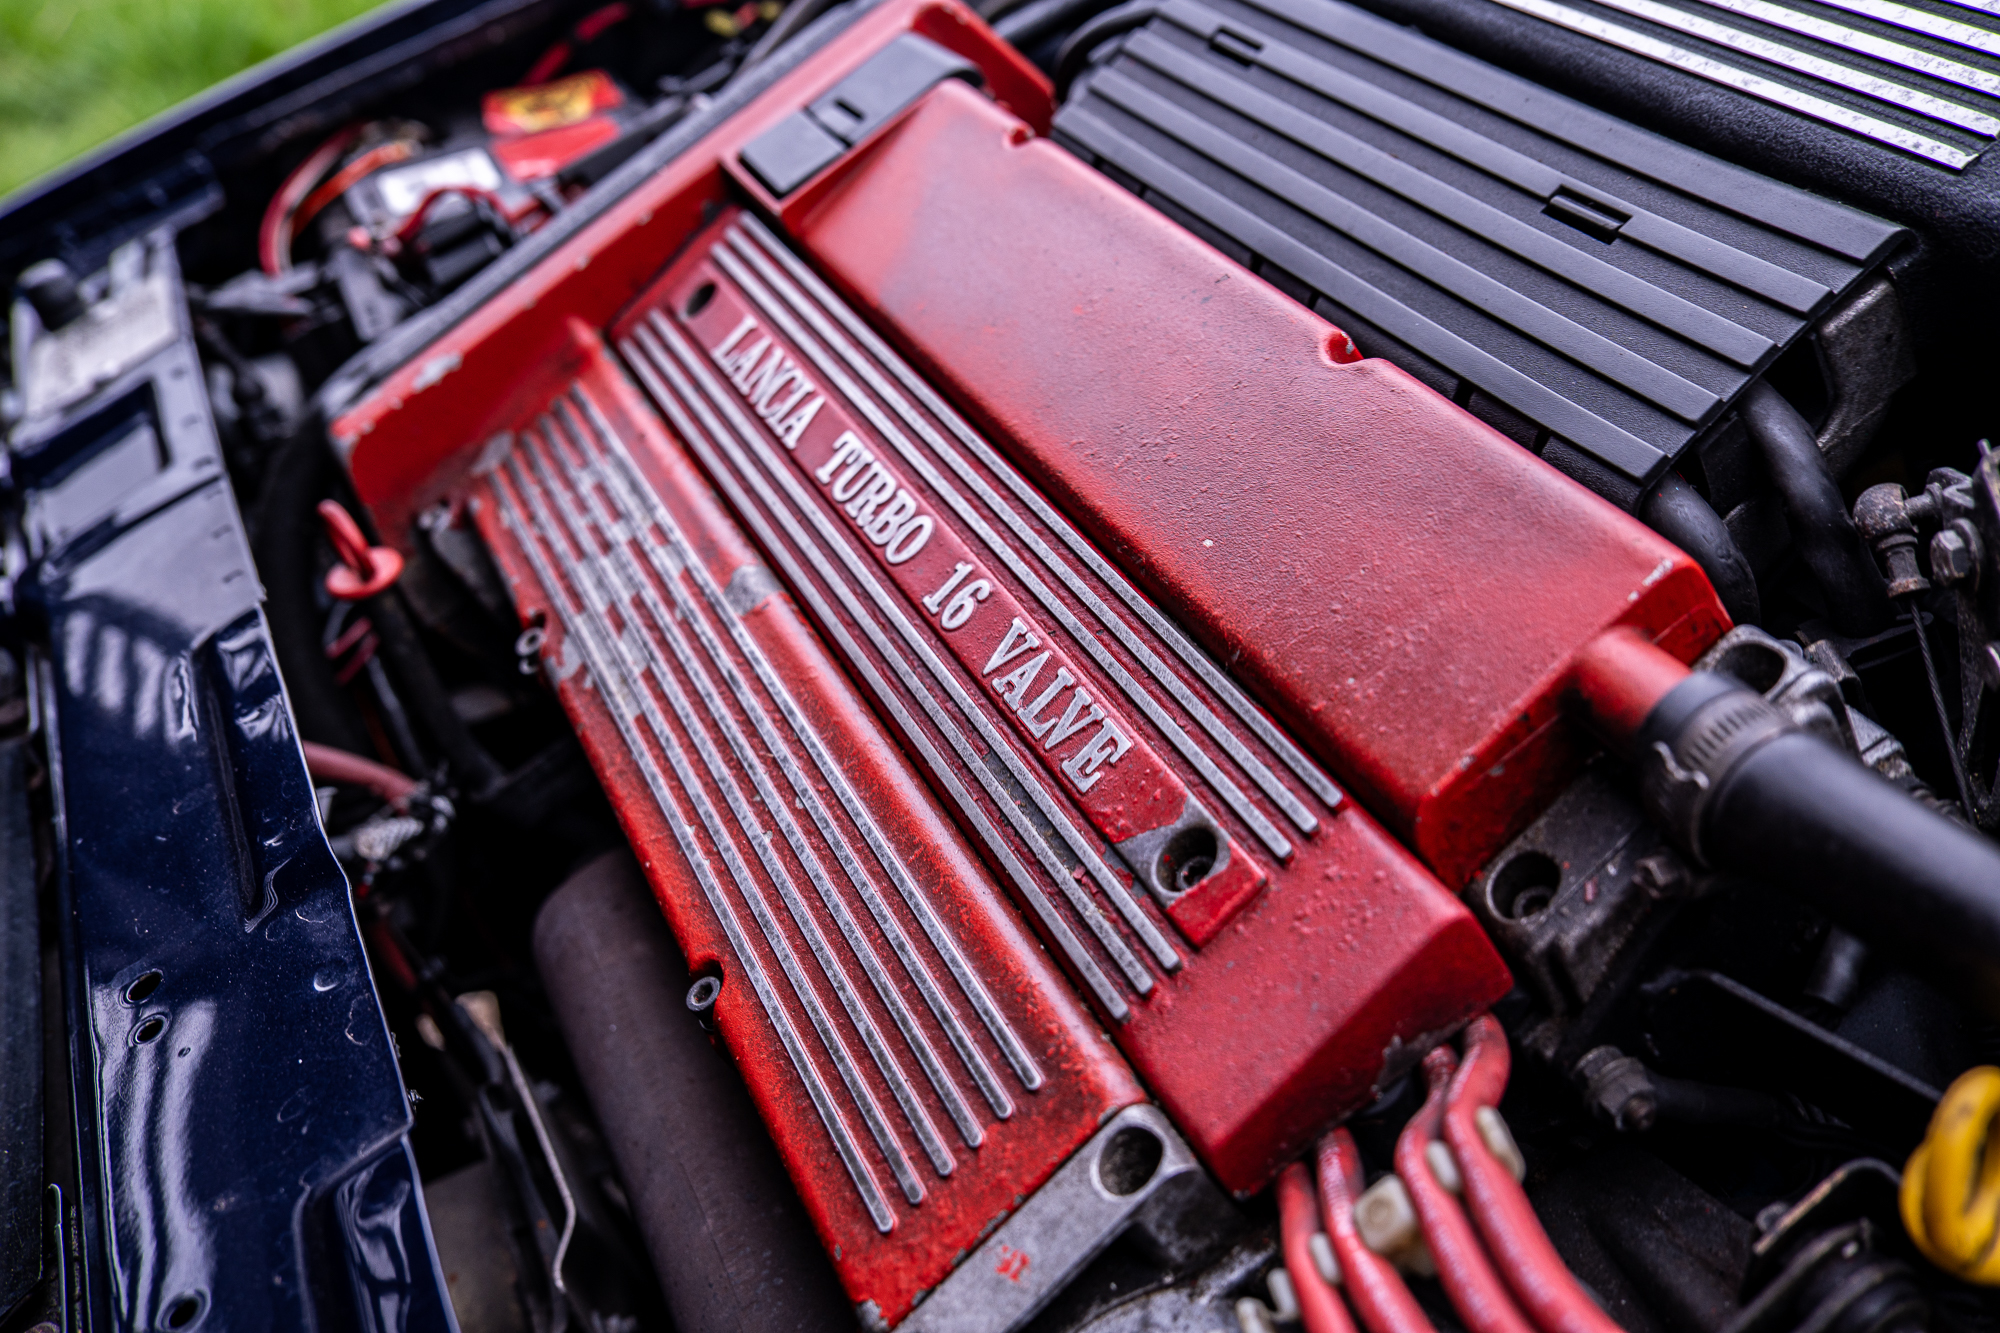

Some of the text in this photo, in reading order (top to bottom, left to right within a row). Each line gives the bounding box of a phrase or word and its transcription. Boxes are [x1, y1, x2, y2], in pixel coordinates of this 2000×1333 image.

[711, 315, 1132, 793] LANCIA TURBO 16 VALVE
